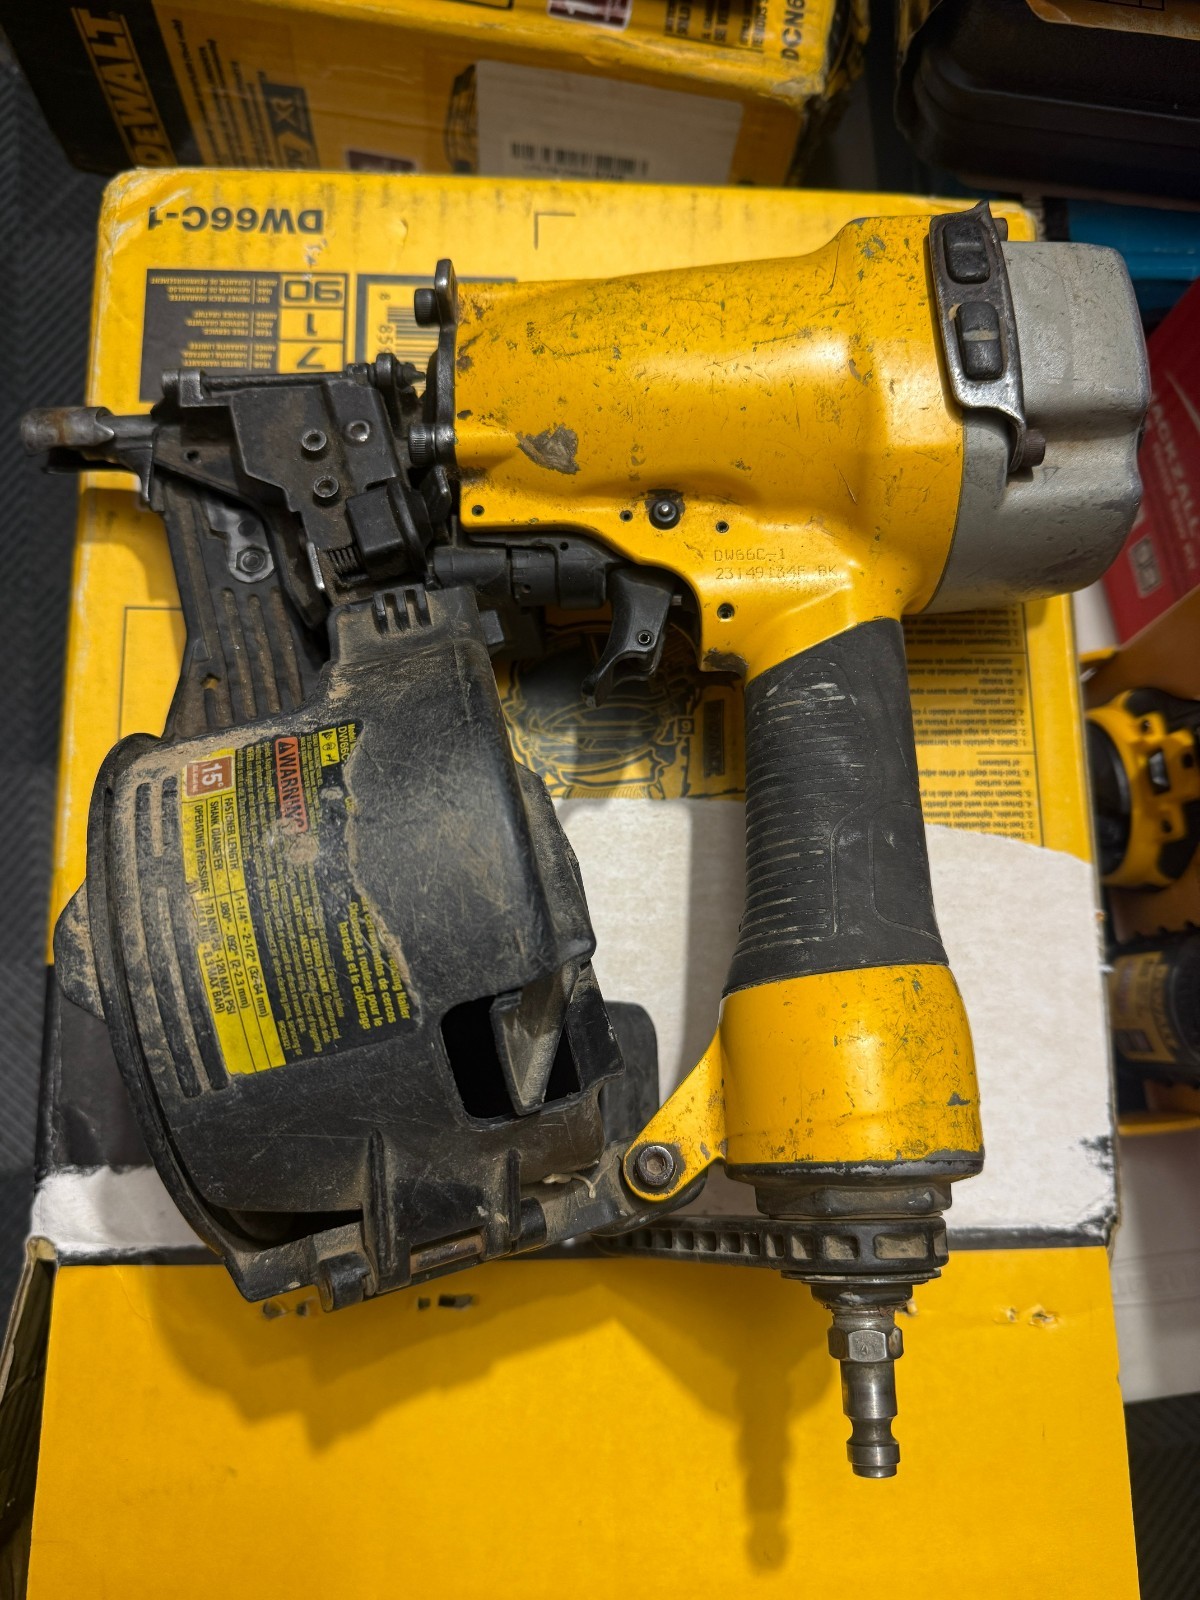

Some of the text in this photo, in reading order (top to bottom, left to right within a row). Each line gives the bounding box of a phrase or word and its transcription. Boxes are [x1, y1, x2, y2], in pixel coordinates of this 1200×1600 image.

[84, 10, 163, 167] DEWALT
[148, 206, 325, 235] DW66C-1
[284, 281, 342, 303] 90
[307, 314, 318, 336] 1
[296, 347, 326, 370] 7
[714, 548, 785, 561] DW66C-1
[680, 720, 691, 732] 6
[209, 801, 224, 870] SHANK DIAMETER
[224, 797, 240, 870] FASTENER LENGTH
[193, 805, 208, 893] OPERATING PRESSURE
[204, 904, 215, 915] 70
[219, 899, 233, 924] .080"
[225, 931, 239, 958] .092"
[234, 895, 249, 926] 1-1/4"
[242, 933, 257, 964] 2-1/2"
[254, 996, 270, 1019] mm)
[230, 959, 246, 986] (2-2.3
[337, 922, 373, 1030] bardage et le clôturage
[358, 956, 375, 993] rouleau
[378, 977, 389, 991] de
[218, 976, 232, 998] MAX
[236, 987, 251, 1010] mm)
[386, 955, 412, 1020] encing Nailer
[211, 990, 226, 1014] BAR)
[224, 998, 236, 1015] PSI
[323, 995, 338, 1027] Operators
[366, 994, 380, 1016] pour
[382, 992, 397, 1024] cercos
[374, 1017, 384, 1027] le
